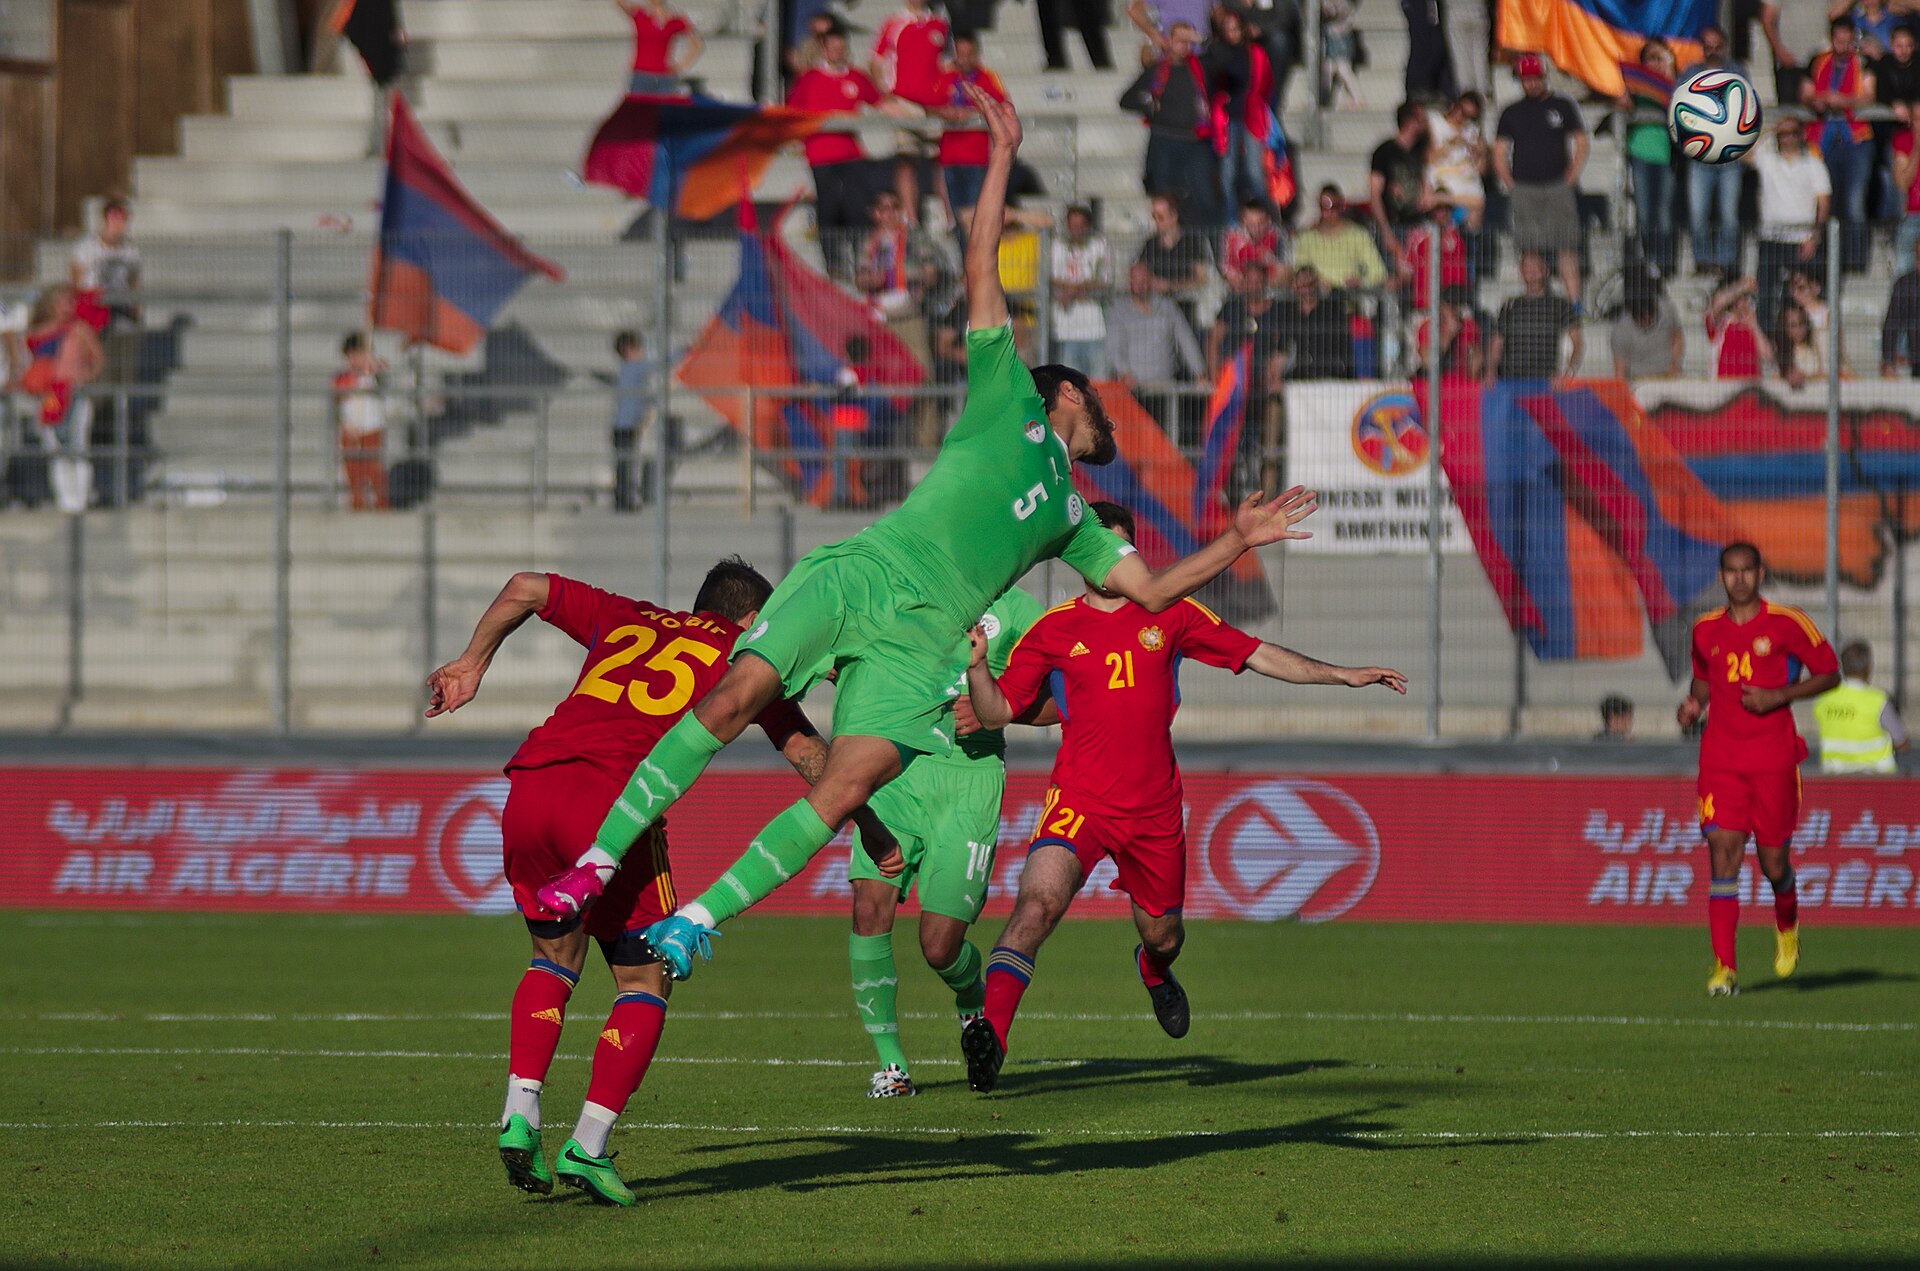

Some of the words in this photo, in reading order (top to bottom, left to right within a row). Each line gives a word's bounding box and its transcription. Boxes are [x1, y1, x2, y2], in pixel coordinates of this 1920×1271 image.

[1014, 481, 1049, 521] 5
[572, 624, 722, 716] 25
[1105, 650, 1135, 690] 21
[1727, 650, 1753, 683] 24
[1047, 807, 1086, 839] 21
[52, 851, 155, 895] AIR
[966, 841, 991, 883] 14
[1588, 861, 1695, 905] AIR
